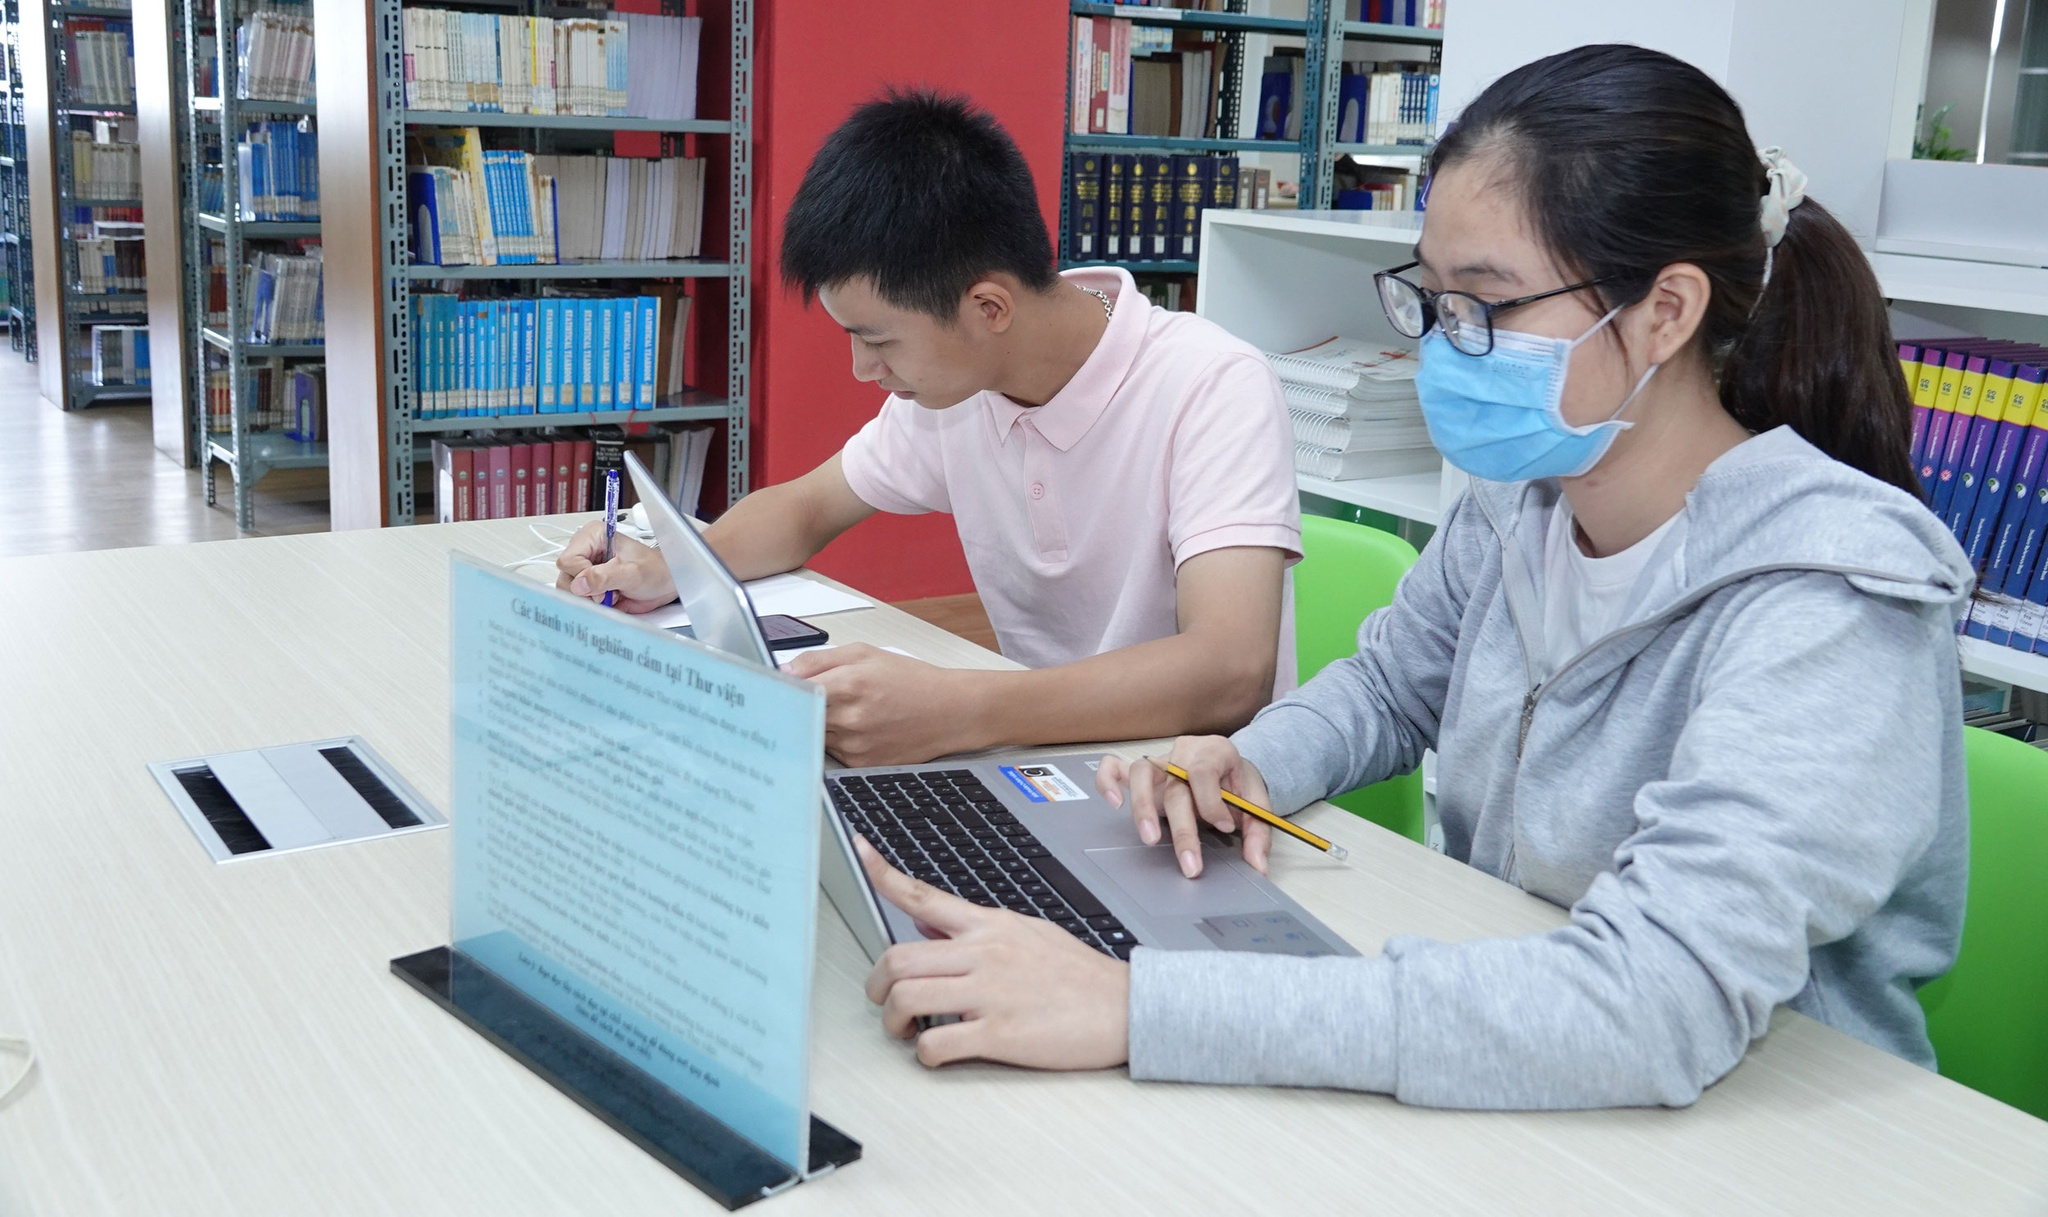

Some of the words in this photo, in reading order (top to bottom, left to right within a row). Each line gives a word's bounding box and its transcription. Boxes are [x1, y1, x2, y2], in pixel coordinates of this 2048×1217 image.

[564, 310, 573, 348] STATISTICAL
[584, 310, 592, 349] STATISTICAL
[645, 308, 653, 348] STATISTICAL
[564, 350, 572, 383] YEARBOOK
[583, 350, 592, 383] YEARBOOK
[644, 348, 652, 381] YEARBOOK
[512, 598, 532, 619] Các
[534, 606, 560, 632] hành
[564, 621, 574, 637] vi
[577, 624, 588, 647] bị
[592, 634, 634, 662] nghiêm
[638, 646, 662, 673] cấm
[665, 663, 682, 684] tại
[686, 667, 714, 694] Thư
[718, 683, 745, 708] viện
